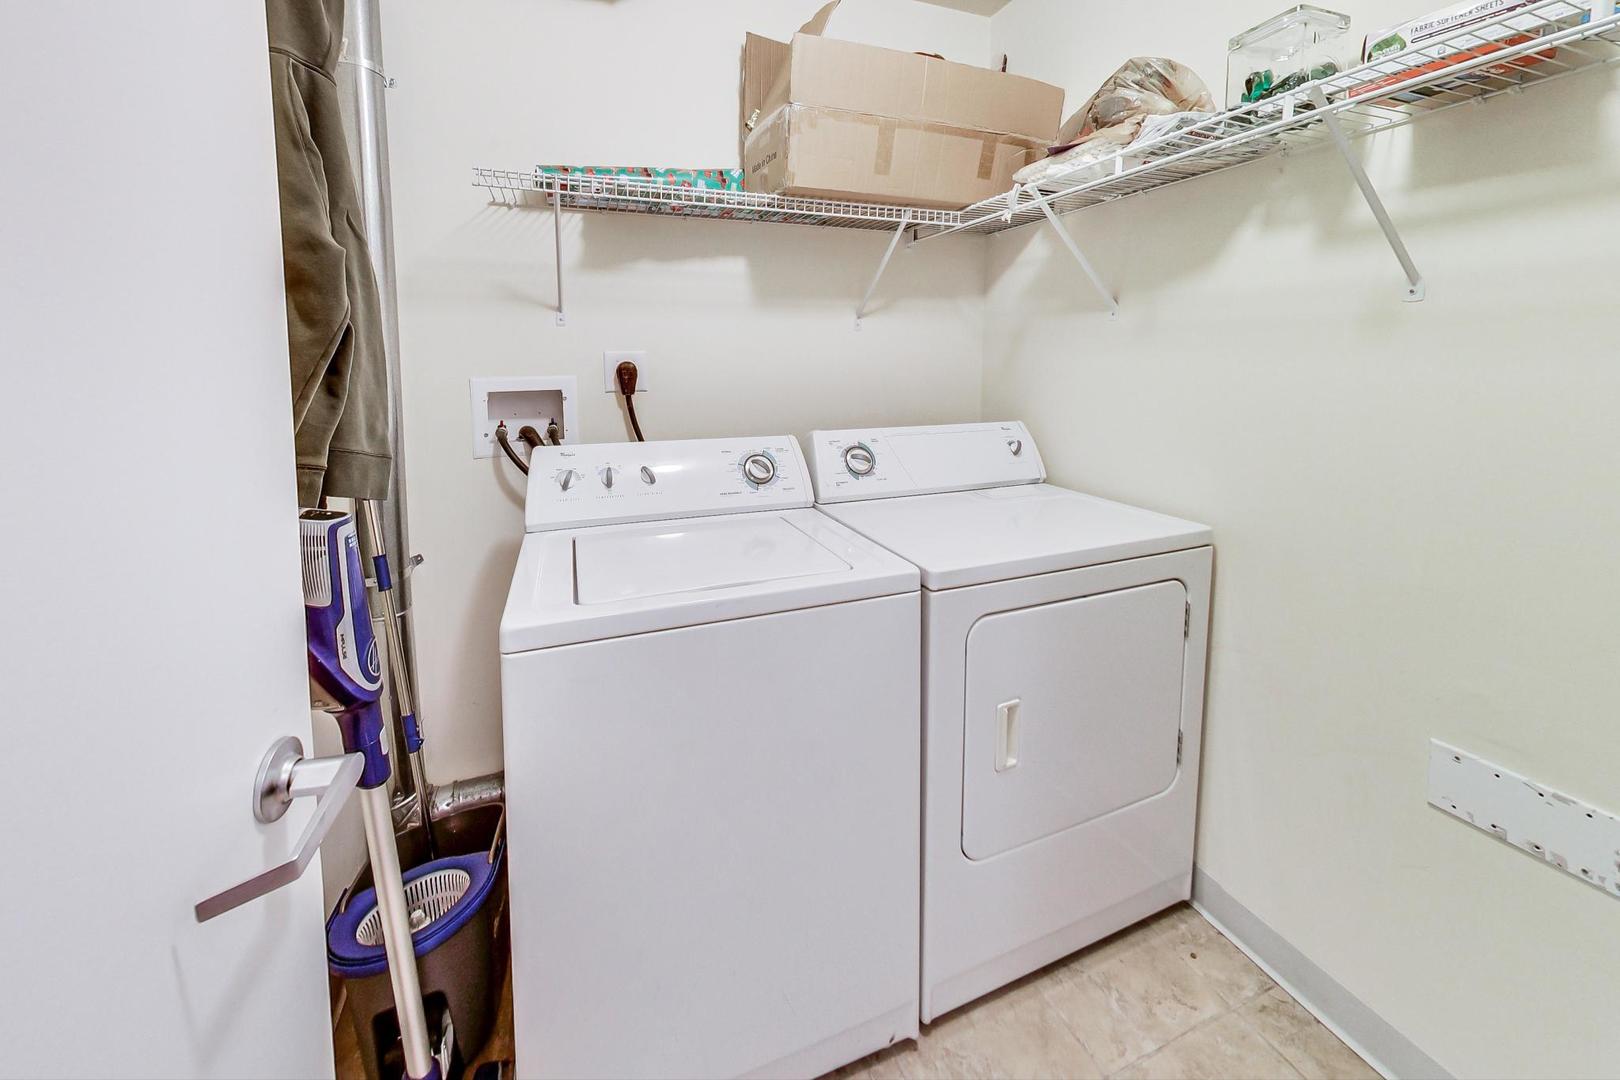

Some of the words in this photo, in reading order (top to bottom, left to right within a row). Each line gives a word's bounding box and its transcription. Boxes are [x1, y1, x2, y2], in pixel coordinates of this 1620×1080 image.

[1410, 22, 1434, 35] FABRIC
[1436, 11, 1473, 25] SOFTENER
[1474, 0, 1504, 13] SHEETS
[766, 152, 776, 164] China
